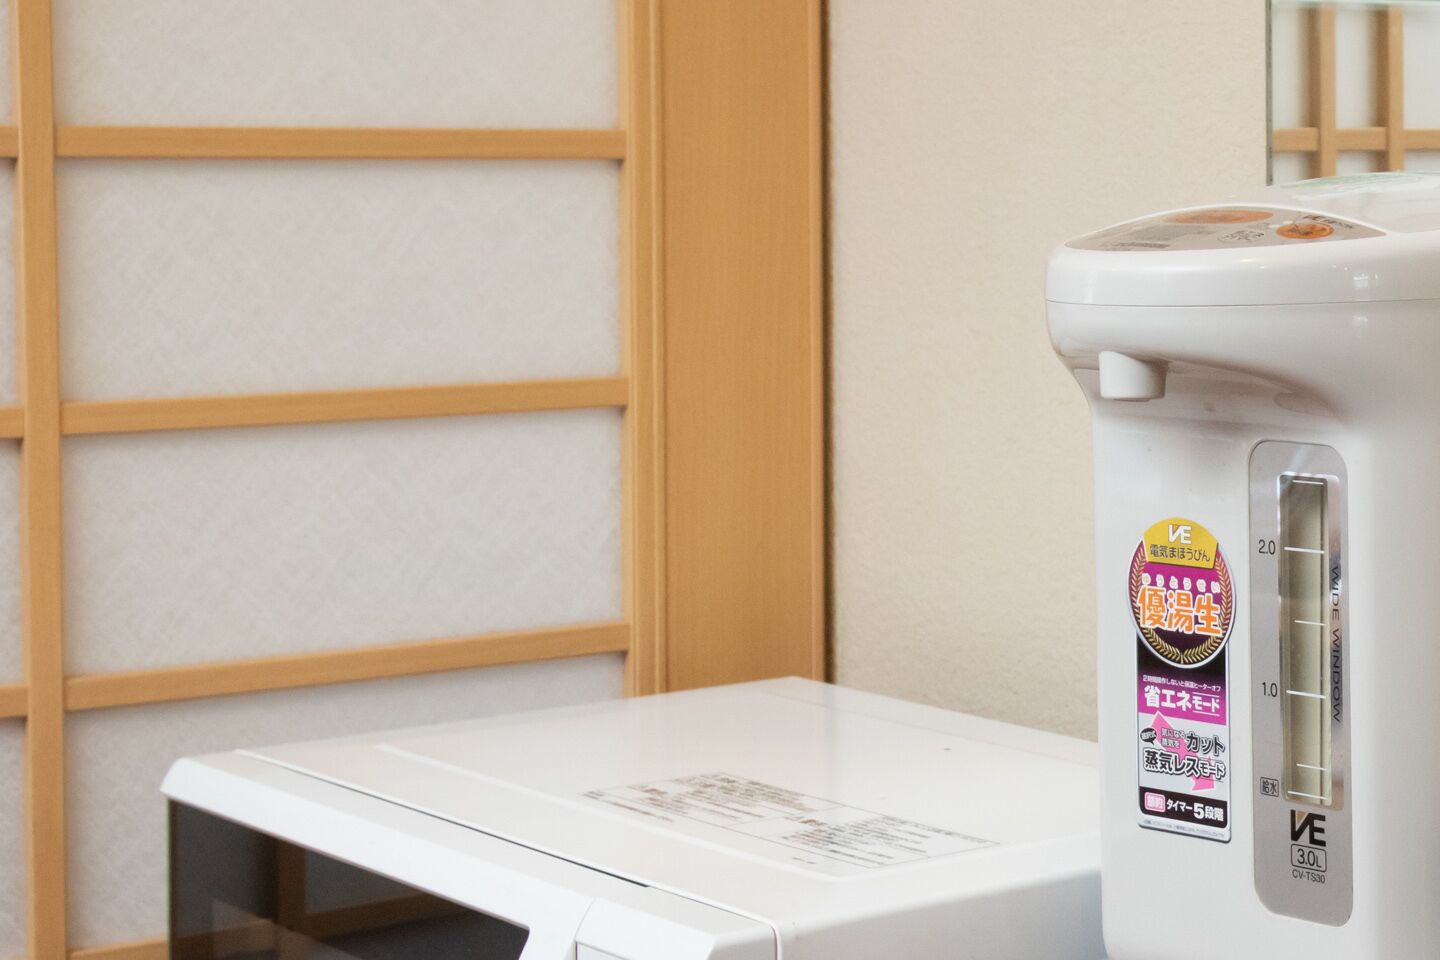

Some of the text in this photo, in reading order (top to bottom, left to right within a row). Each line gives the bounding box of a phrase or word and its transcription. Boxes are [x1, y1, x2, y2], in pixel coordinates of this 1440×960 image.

[1150, 543, 1211, 562] 電気まほうびん
[1258, 540, 1276, 556] 2.0
[1137, 585, 1222, 637] 優湯生
[1330, 566, 1342, 723] WIDE WINDOW
[1144, 685, 1220, 713] 省エネモード
[1261, 682, 1278, 698] 1.0
[1143, 748, 1227, 780] 蒸気レスモード
[1297, 848, 1322, 868] 3.0L
[1291, 868, 1326, 885] CV-TS30
